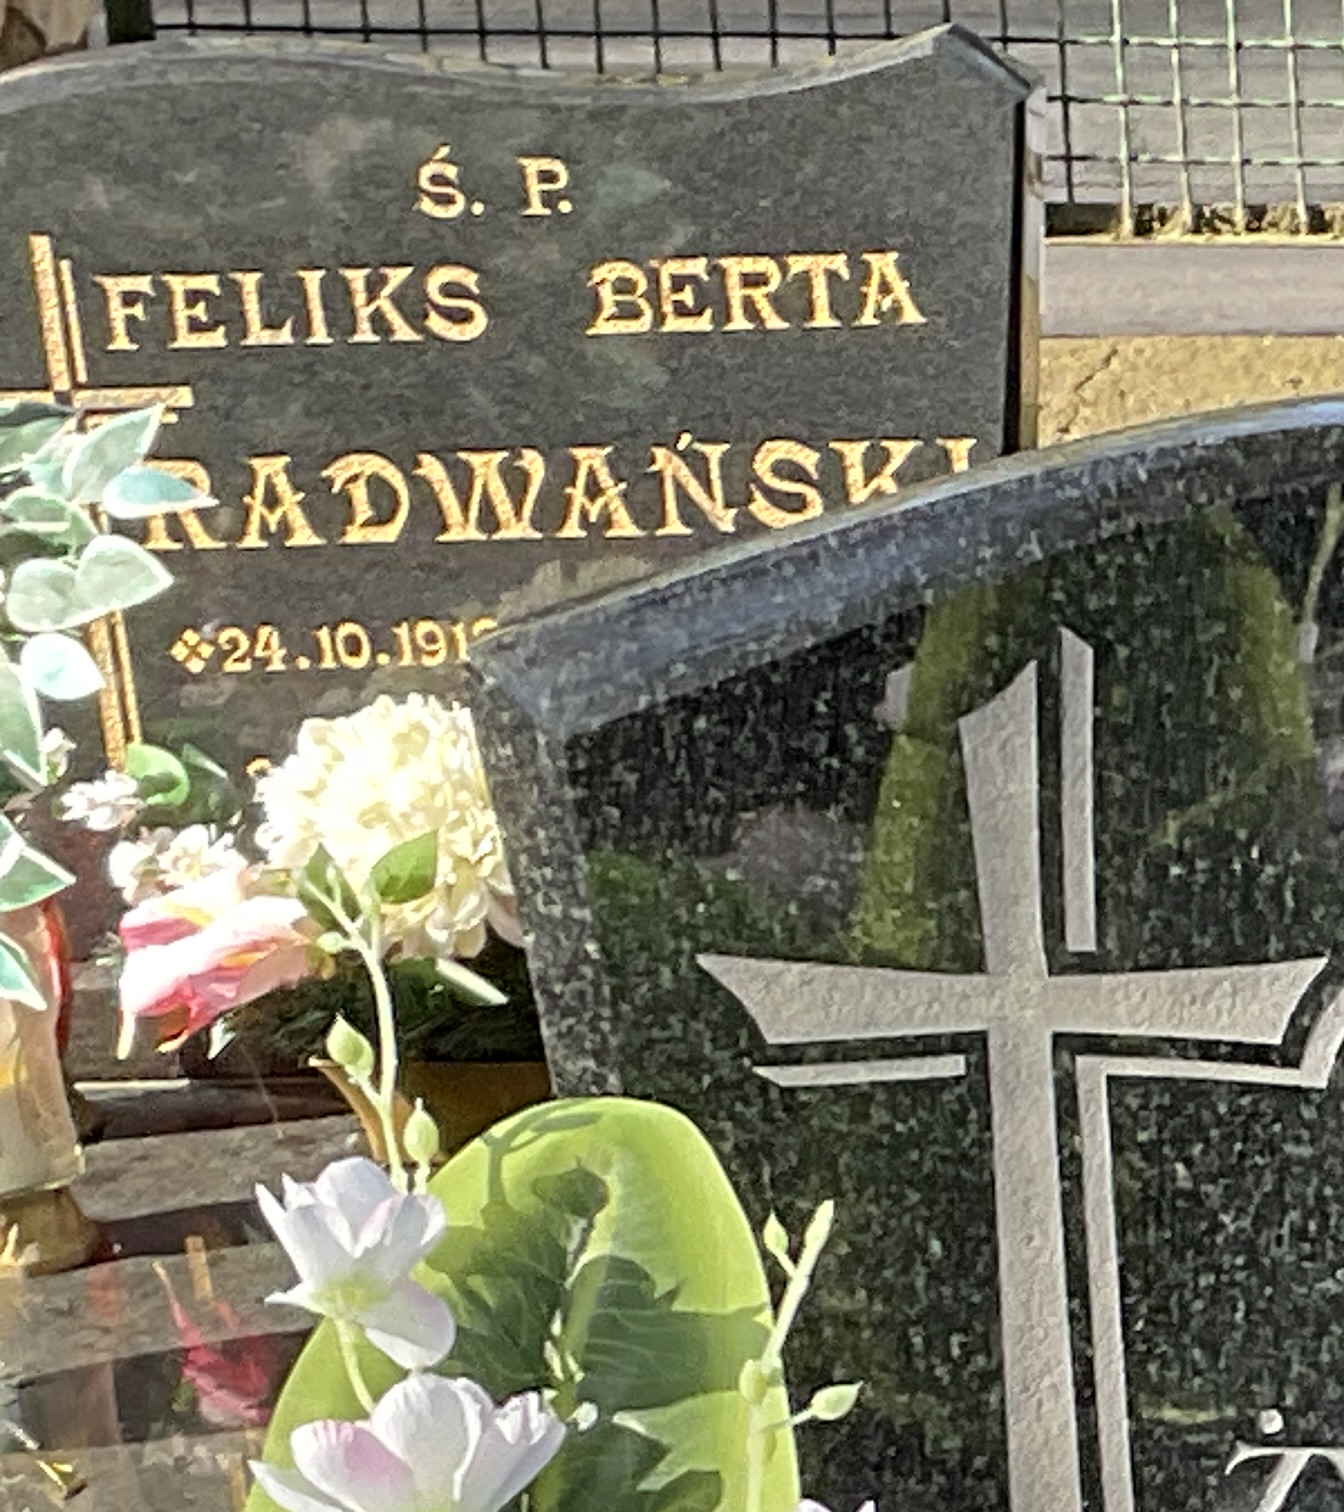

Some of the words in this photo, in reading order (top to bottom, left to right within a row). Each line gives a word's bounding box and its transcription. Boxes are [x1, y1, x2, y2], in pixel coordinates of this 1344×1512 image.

[413, 145, 485, 218] Ś.
[515, 157, 573, 216] P.
[92, 265, 489, 351] FELIKS
[584, 250, 929, 336] BERTA
[216, 616, 498, 673] 24.10.191
